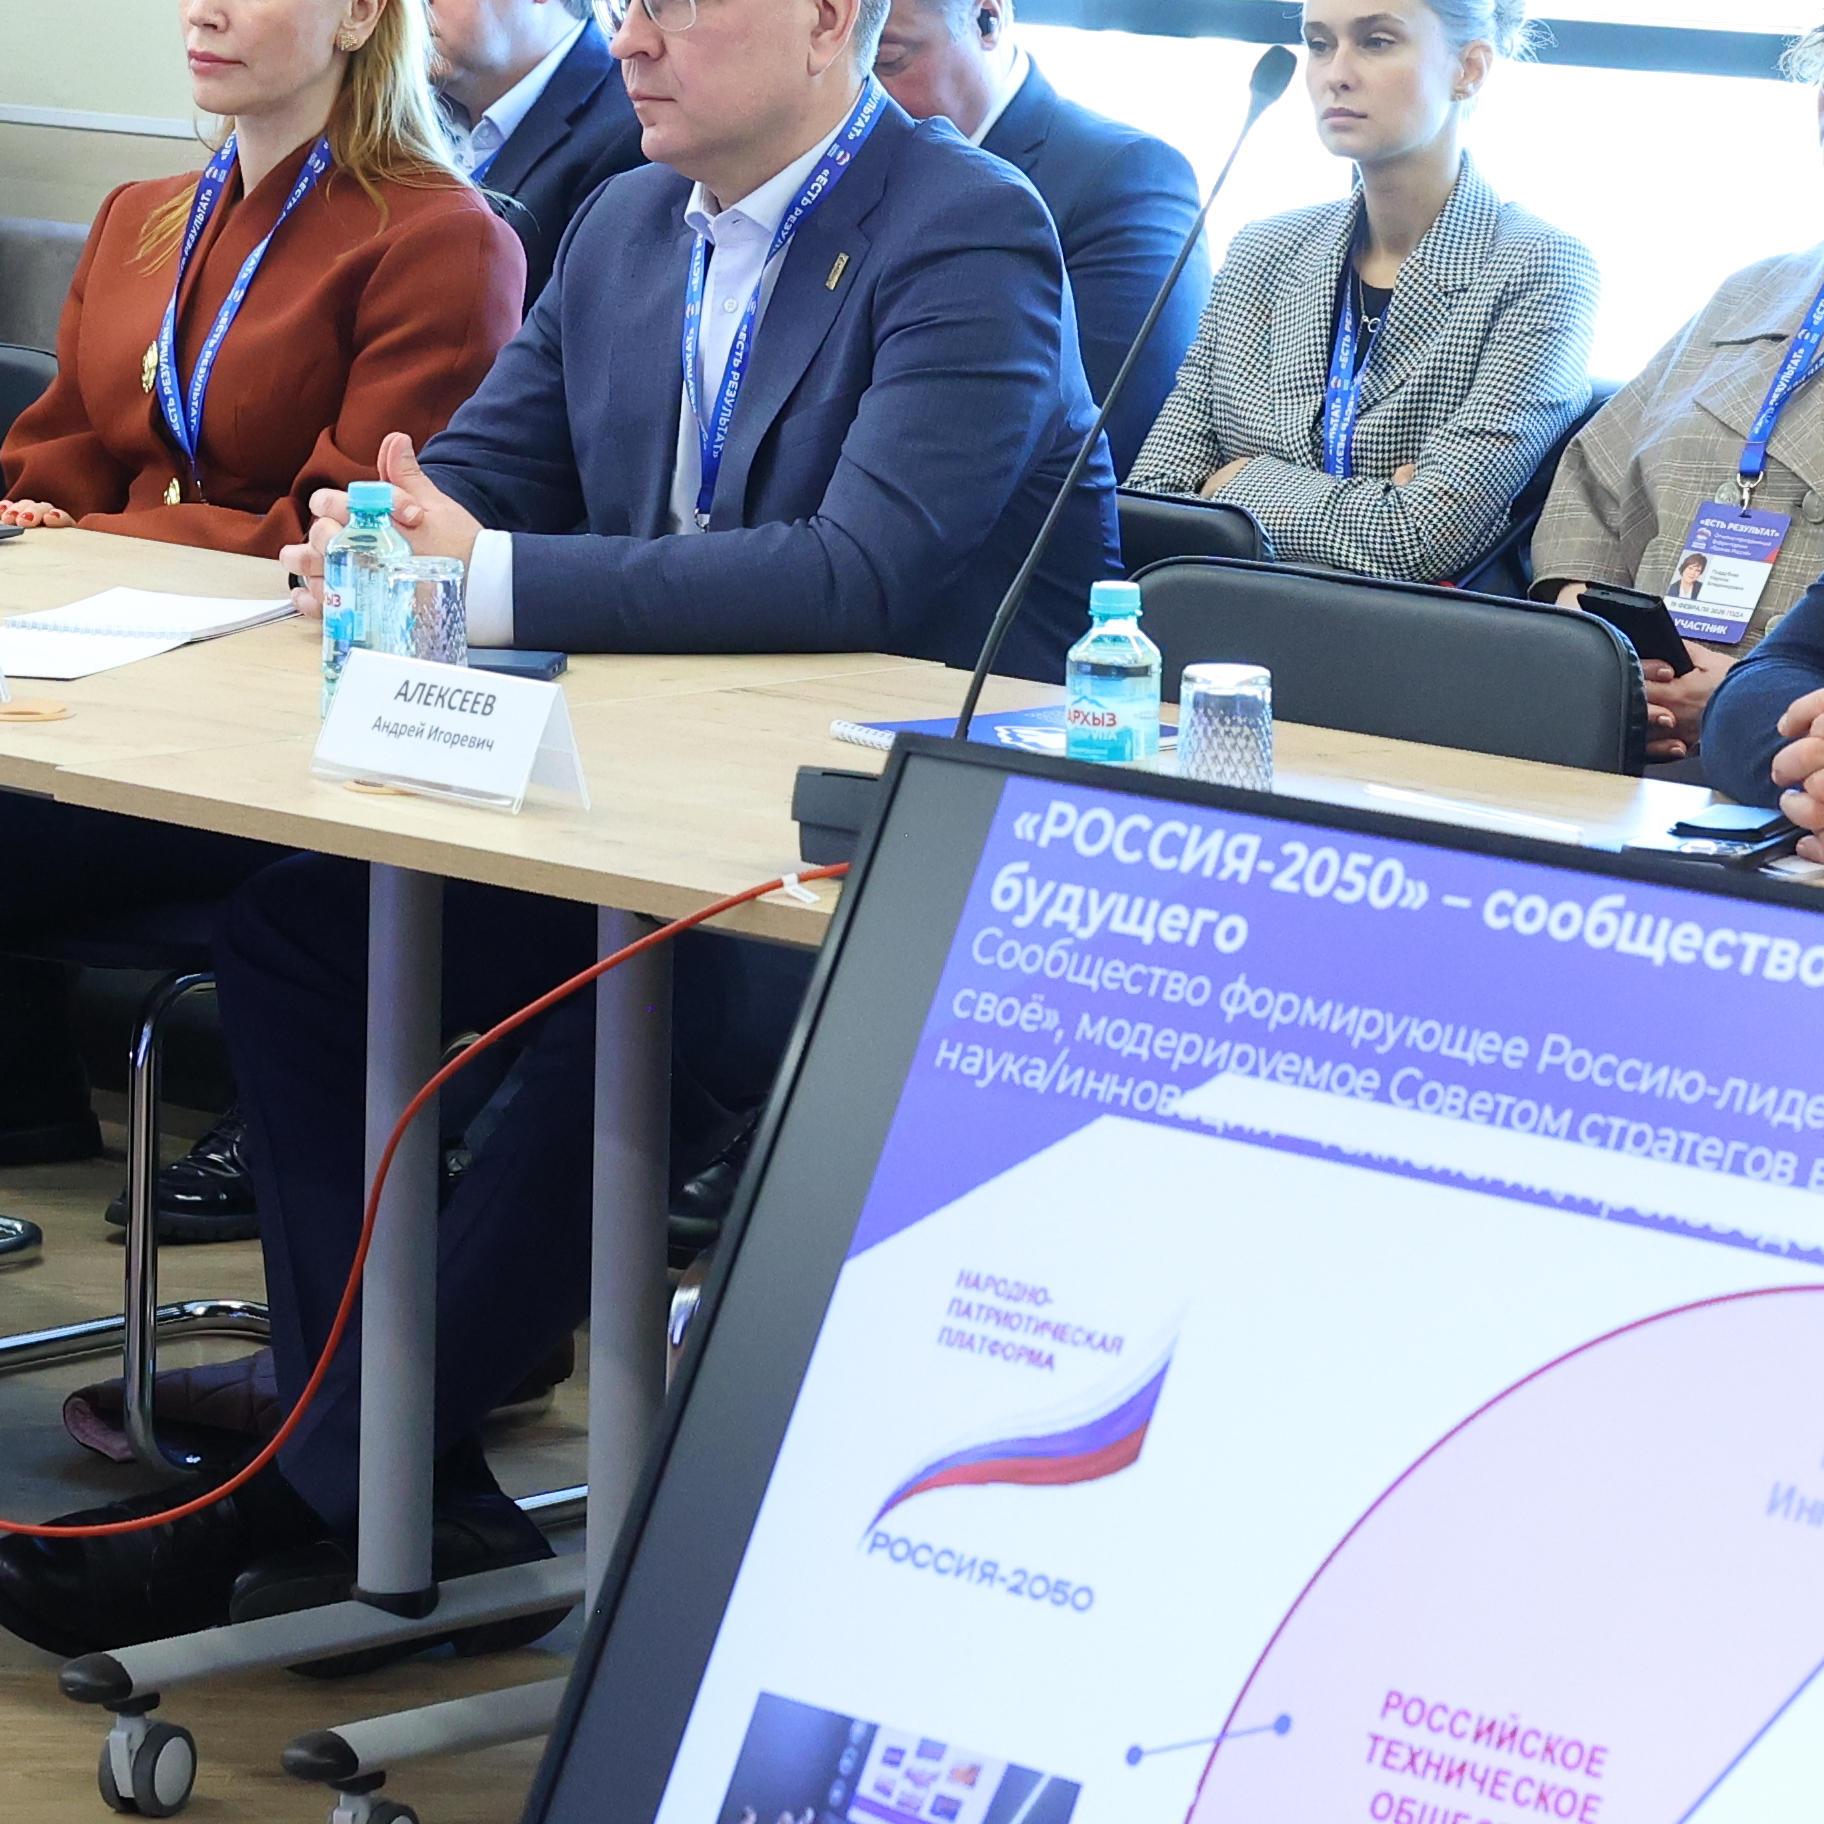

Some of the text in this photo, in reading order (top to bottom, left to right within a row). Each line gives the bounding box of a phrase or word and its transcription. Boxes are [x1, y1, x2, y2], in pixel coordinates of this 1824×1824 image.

[801, 168, 831, 212] «ЕСТЬ
[189, 310, 230, 432] «ЕСТЬ РЕЗУЛЬТАТ»
[711, 323, 749, 459] «ЕСТЬ РЕЗУЛЬТАТ»
[1699, 518, 1780, 537] «ЕСТЬ РЕЗУЛЬТАТ»
[1674, 618, 1727, 635] УЧАСТНИК
[1678, 602, 1709, 613] ФЕВРАЛЯ
[1726, 609, 1744, 618] ГОДА
[371, 715, 495, 752] Андрей Игоревич
[393, 679, 497, 717] АЛЕКСЕЕВ
[1013, 801, 1429, 912] «РОССИЯ-2050»
[989, 860, 1249, 954] будущего
[970, 926, 1210, 1008] Сообщество
[1218, 973, 1529, 1070] формирующее
[952, 984, 1065, 1045] своё»,
[1074, 1011, 1381, 1101] модерируемое
[1387, 1067, 1572, 1140] Советом
[1577, 1112, 1798, 1186] стратегов
[955, 1268, 1055, 1307] НАРОДНО-
[937, 1325, 1057, 1373] ПЛАТФОРМА
[946, 1297, 1126, 1357] ПАТРИОТИЧЕСКАЯ
[867, 1530, 1095, 1613] РОССИЯ-2050
[1379, 1688, 1609, 1780] РОССИЙСКОЕ
[1366, 1731, 1604, 1824] ТЕХНИЧЕСКОЕ
